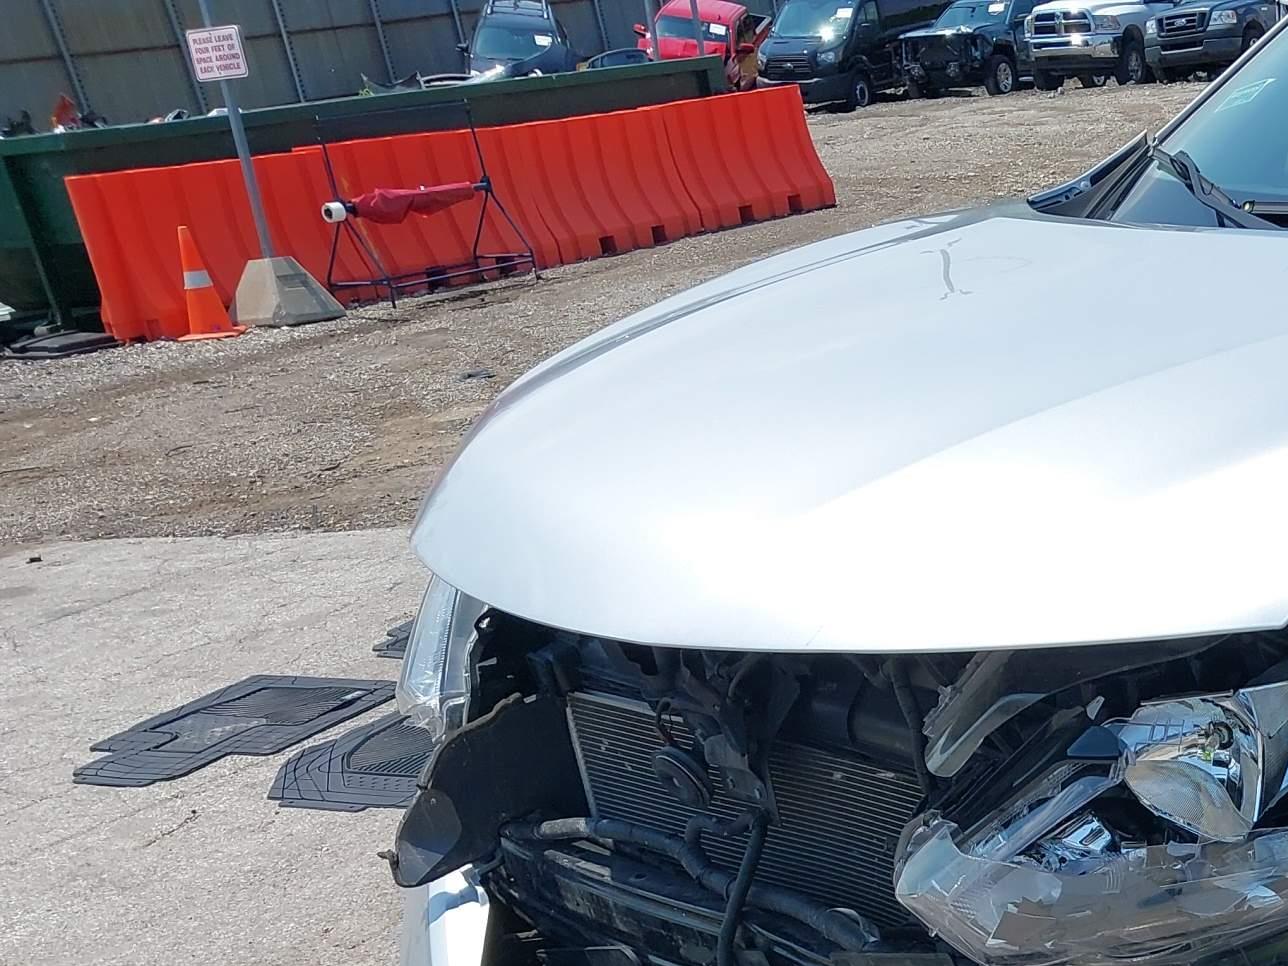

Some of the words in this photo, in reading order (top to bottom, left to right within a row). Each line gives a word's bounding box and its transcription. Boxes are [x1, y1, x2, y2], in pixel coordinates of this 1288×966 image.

[192, 37, 213, 45] PLEASE
[214, 33, 233, 42] LEAVE
[195, 47, 210, 55] FOUR
[211, 45, 225, 53] FEET
[227, 43, 236, 51] OF
[196, 56, 213, 64] SPACE
[215, 53, 240, 62] AROUND
[216, 62, 241, 72] VEHICLE
